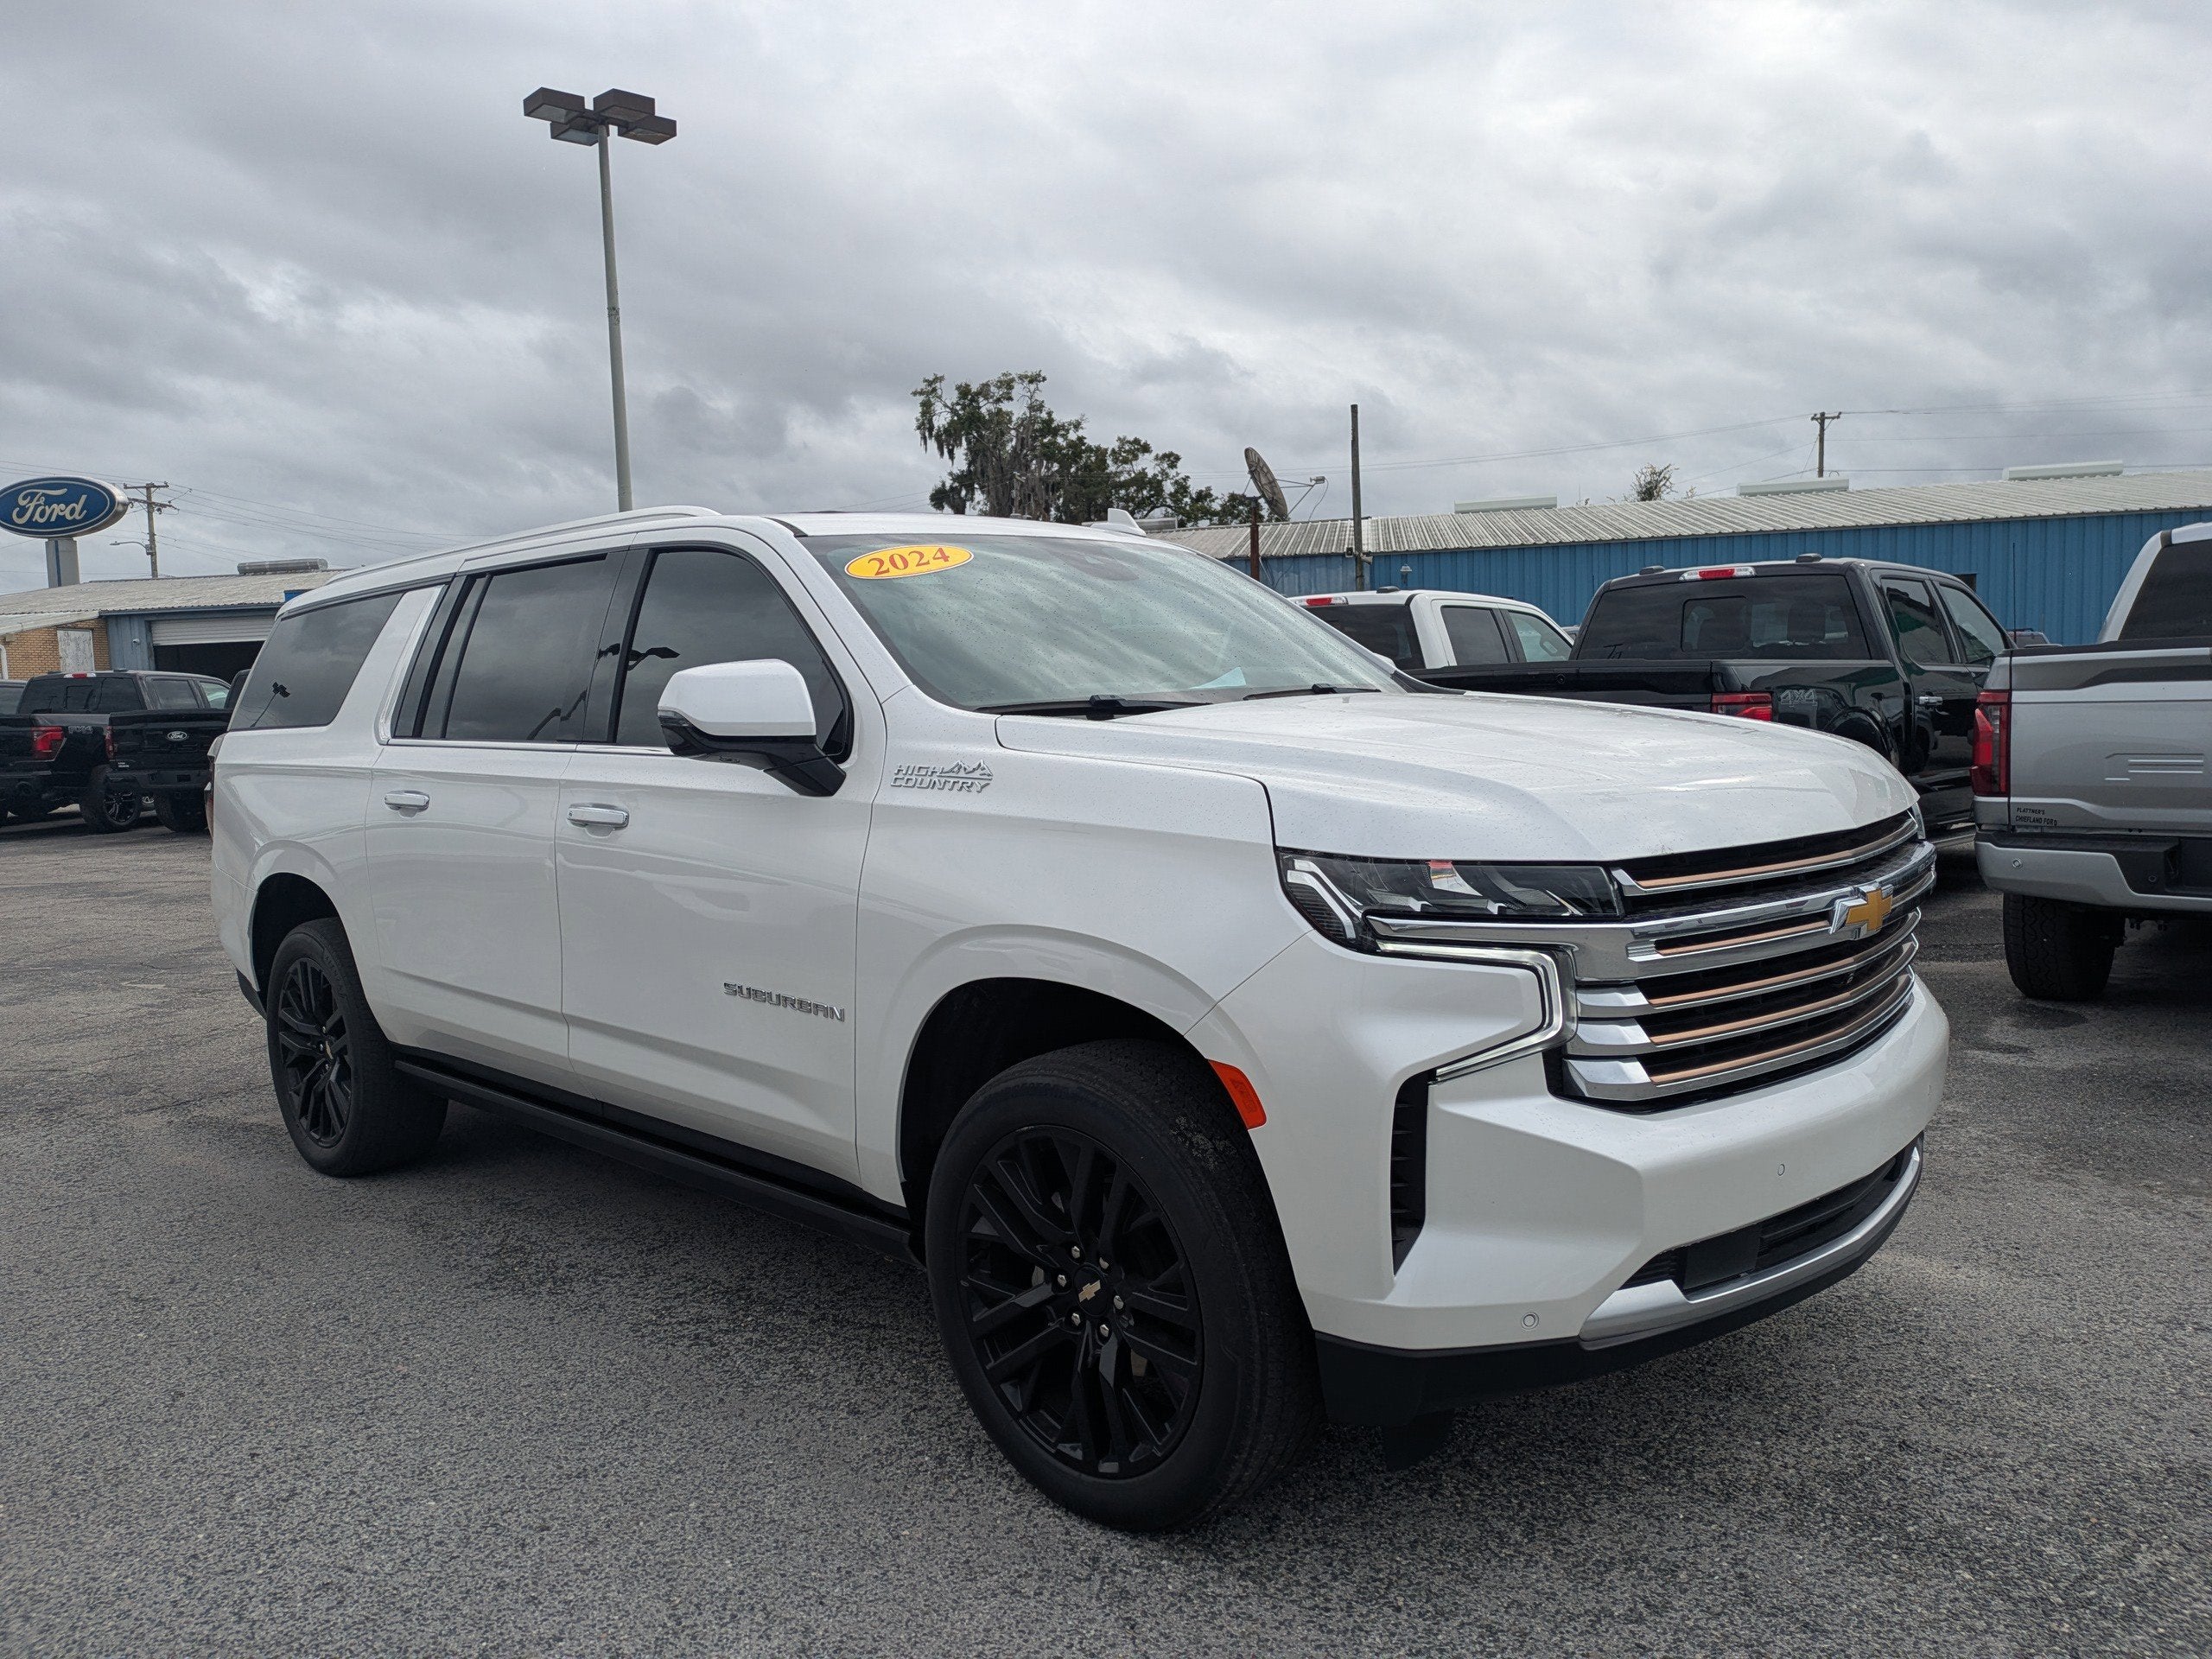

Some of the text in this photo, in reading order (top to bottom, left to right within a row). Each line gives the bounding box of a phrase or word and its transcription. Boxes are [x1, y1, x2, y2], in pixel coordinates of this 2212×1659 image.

[12, 488, 87, 524] Ford
[868, 547, 950, 576] 2024
[893, 765, 946, 777] HIGH
[890, 777, 990, 793] COUNTRY
[2015, 815, 2058, 826] CHIEFLAND FORD
[723, 982, 845, 1022] SUBURBAN
